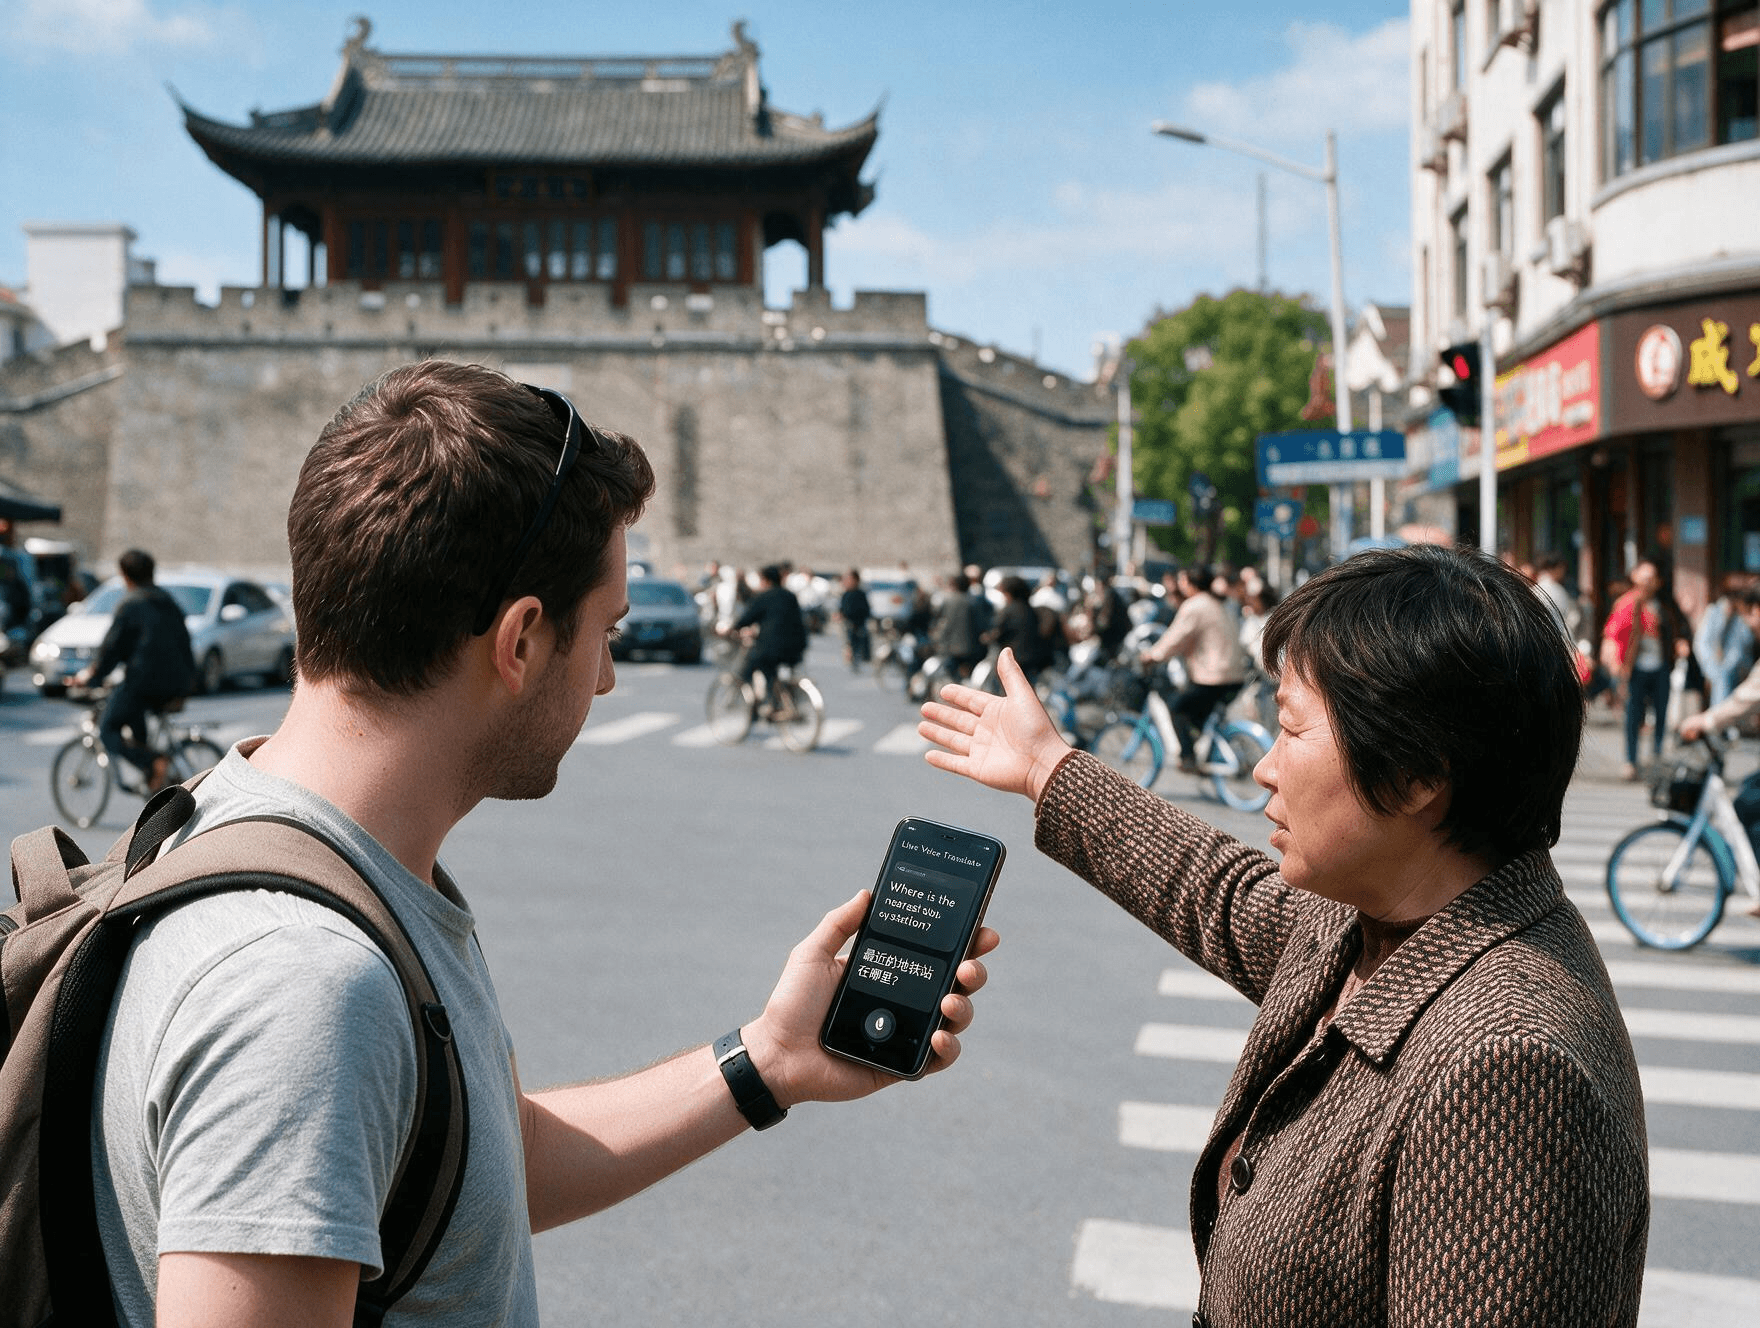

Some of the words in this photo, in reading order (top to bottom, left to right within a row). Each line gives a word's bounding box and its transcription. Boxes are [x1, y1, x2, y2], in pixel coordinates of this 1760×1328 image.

[884, 897, 922, 913] nearest
[890, 880, 925, 899] Where
[926, 890, 936, 902] is
[938, 894, 956, 908] the
[862, 947, 935, 981] 最近的地铁站
